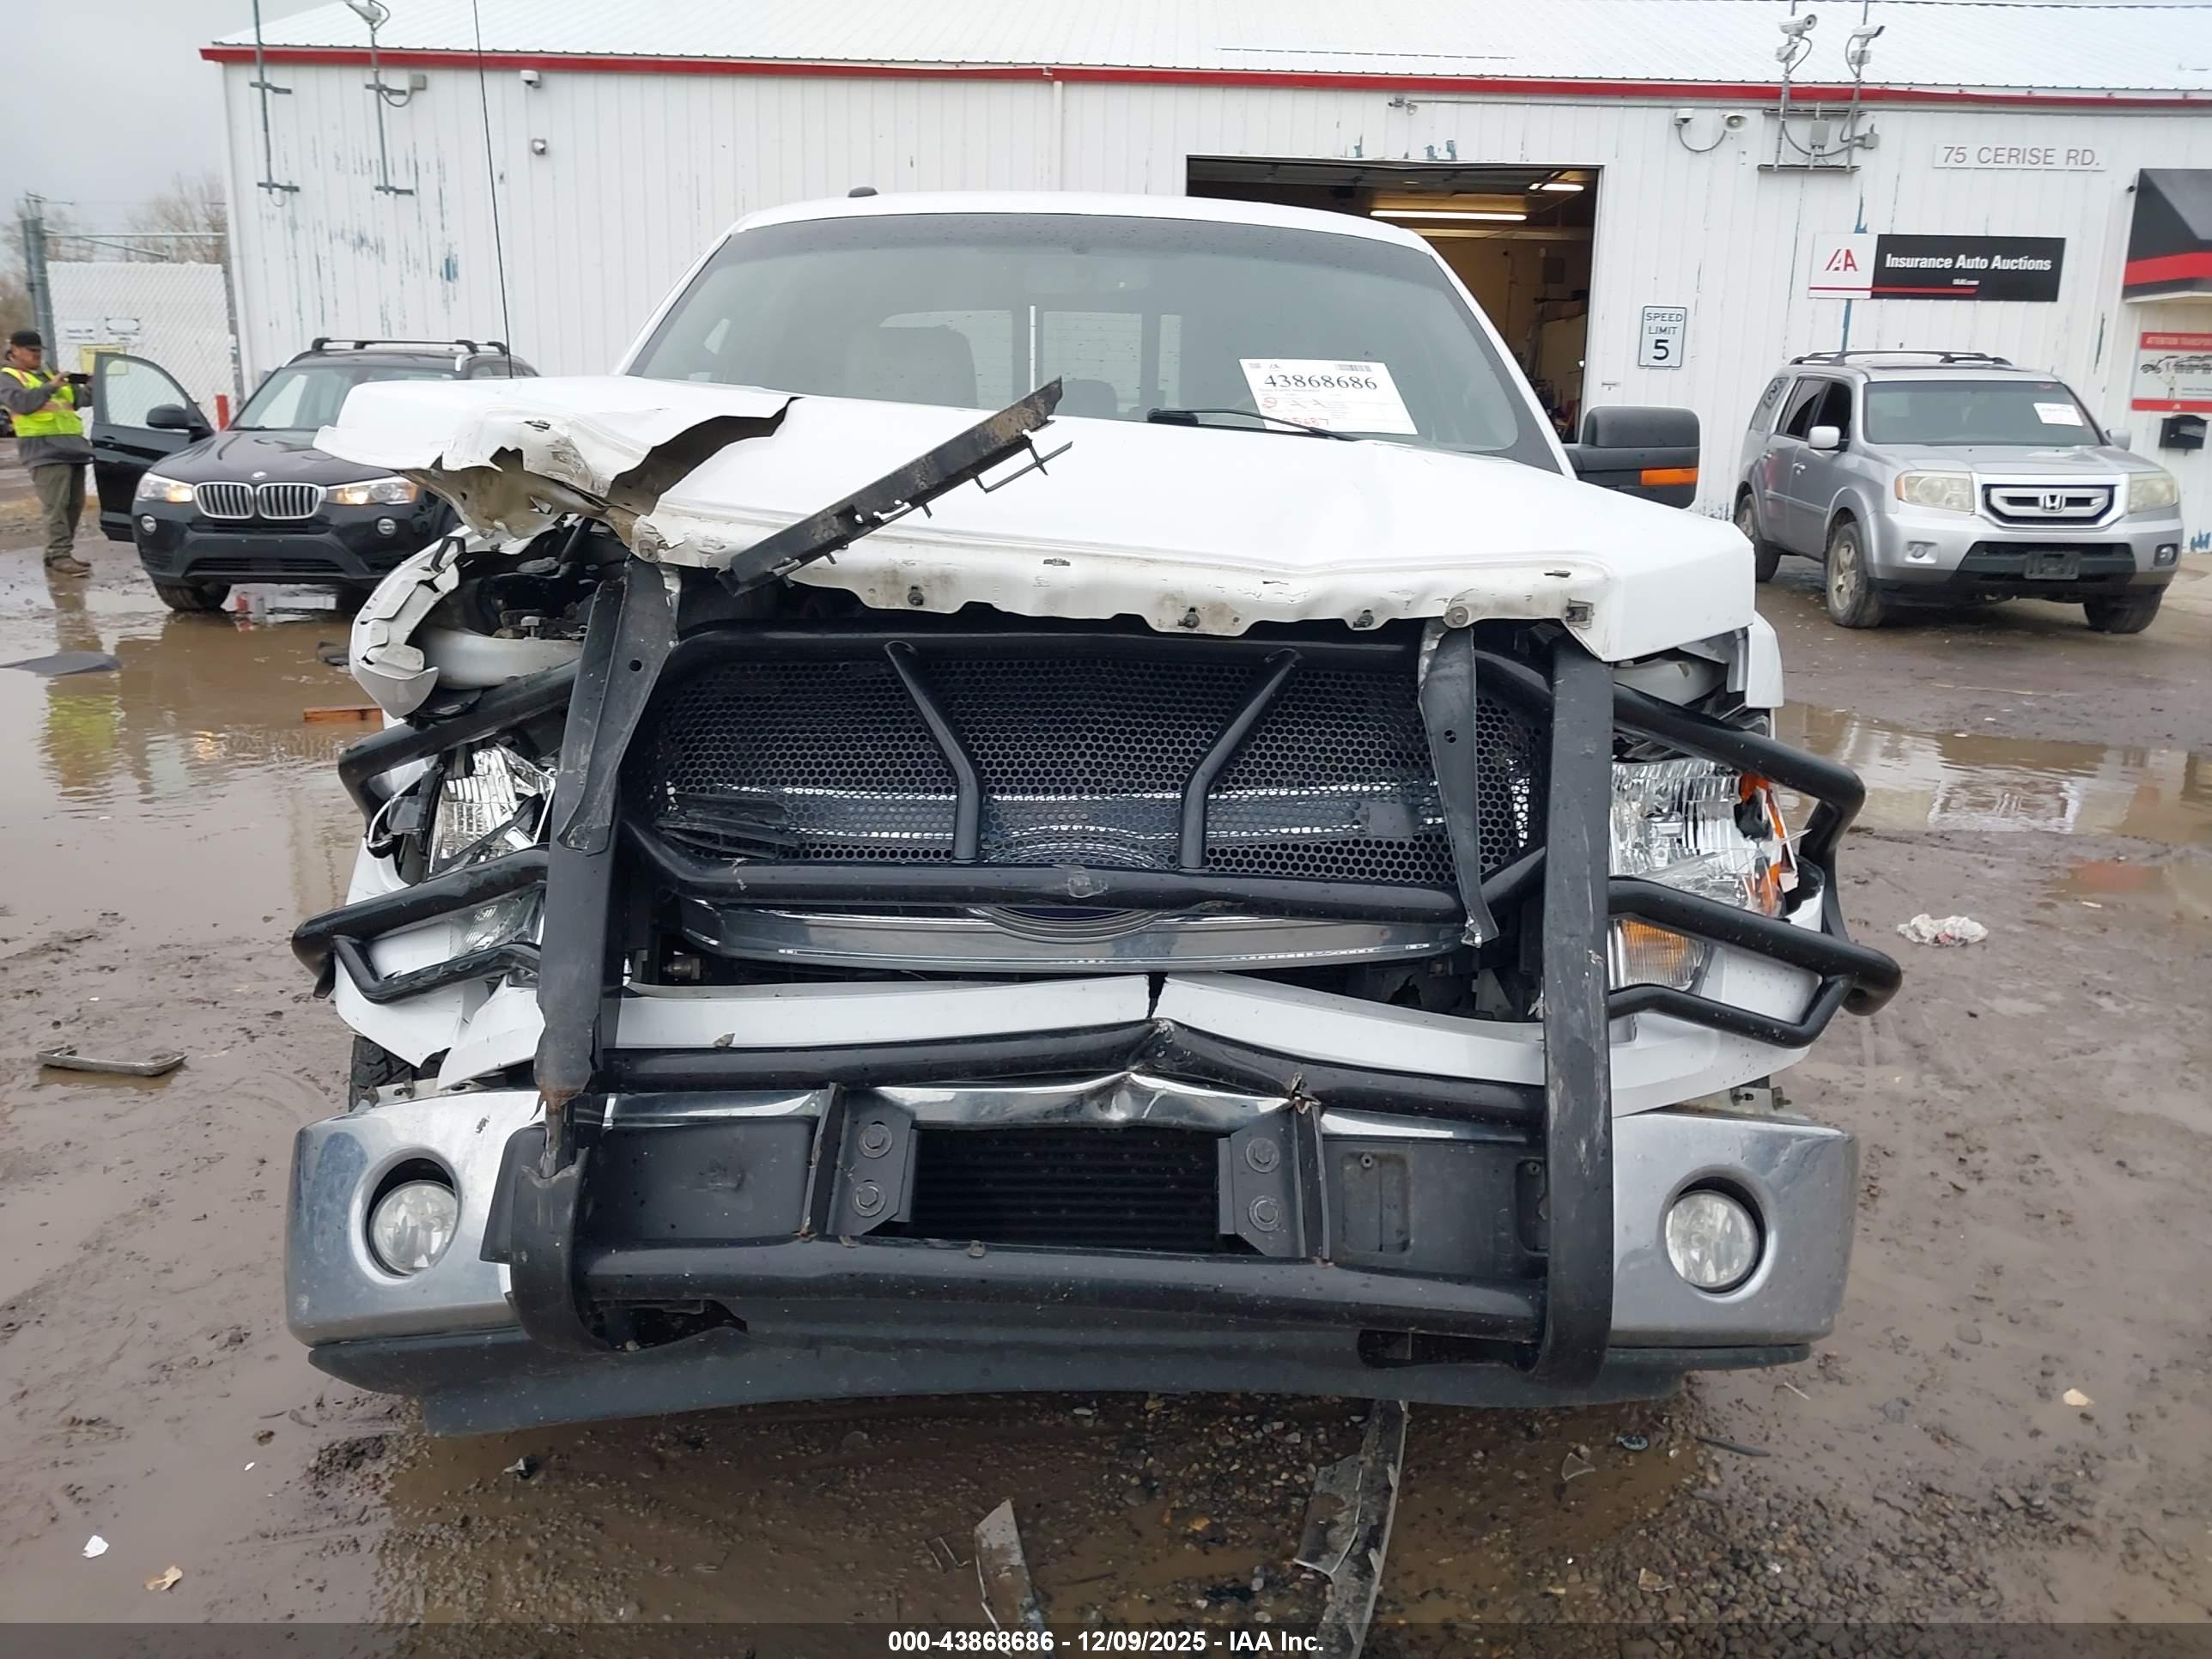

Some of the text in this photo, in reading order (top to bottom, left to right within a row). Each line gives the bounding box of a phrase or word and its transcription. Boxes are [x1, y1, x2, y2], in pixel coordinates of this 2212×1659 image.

[1943, 146, 2100, 166] 75 CERISE RD.
[1885, 253, 2052, 270] Insurance Auto Auctions
[1645, 312, 1683, 322] SPEED
[1648, 325, 1678, 335] LIMIT
[1652, 338, 1670, 361] 5
[1264, 374, 1377, 391] 43868686
